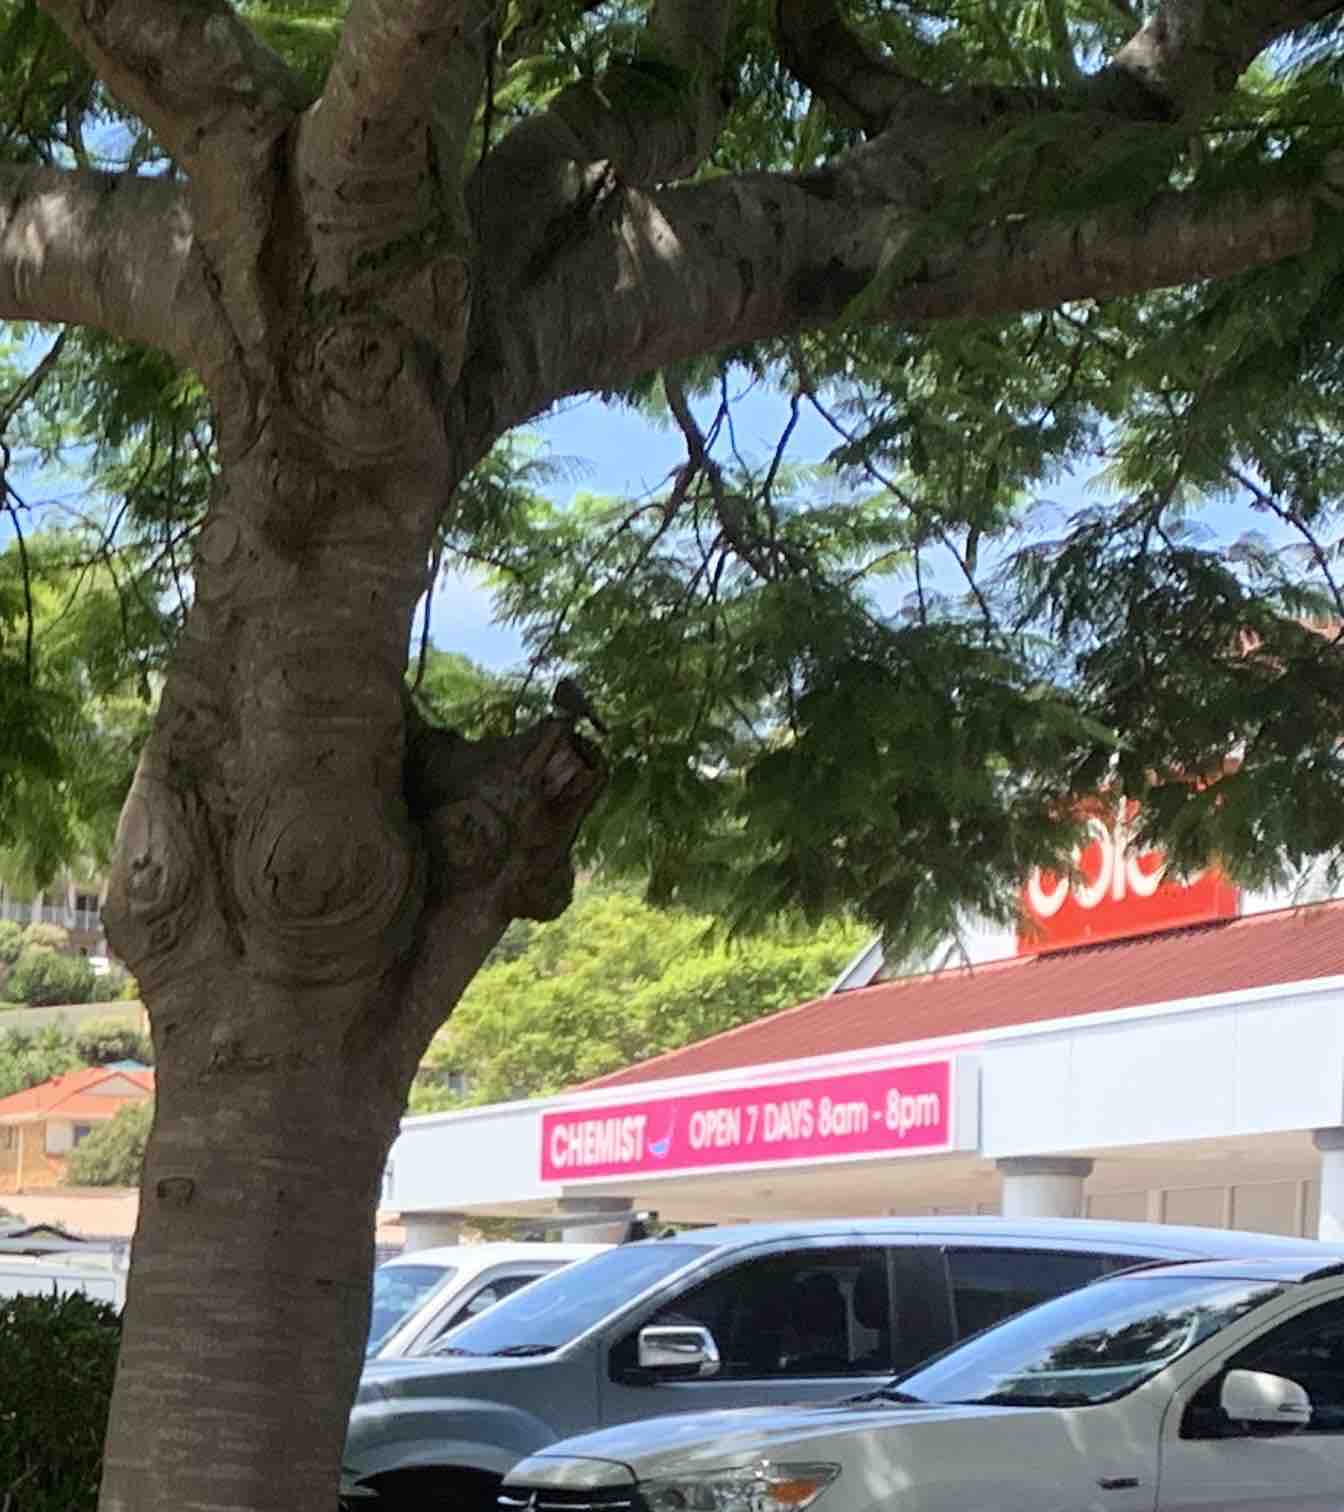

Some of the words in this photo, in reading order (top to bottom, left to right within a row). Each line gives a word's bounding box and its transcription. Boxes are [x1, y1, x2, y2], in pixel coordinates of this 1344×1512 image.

[550, 1114, 647, 1168] CHEMIST
[689, 1107, 741, 1150] OPEN
[745, 1104, 760, 1146] 7
[763, 1098, 814, 1143] DAYS
[818, 1096, 868, 1137] 8am
[885, 1087, 940, 1138] 8pm
